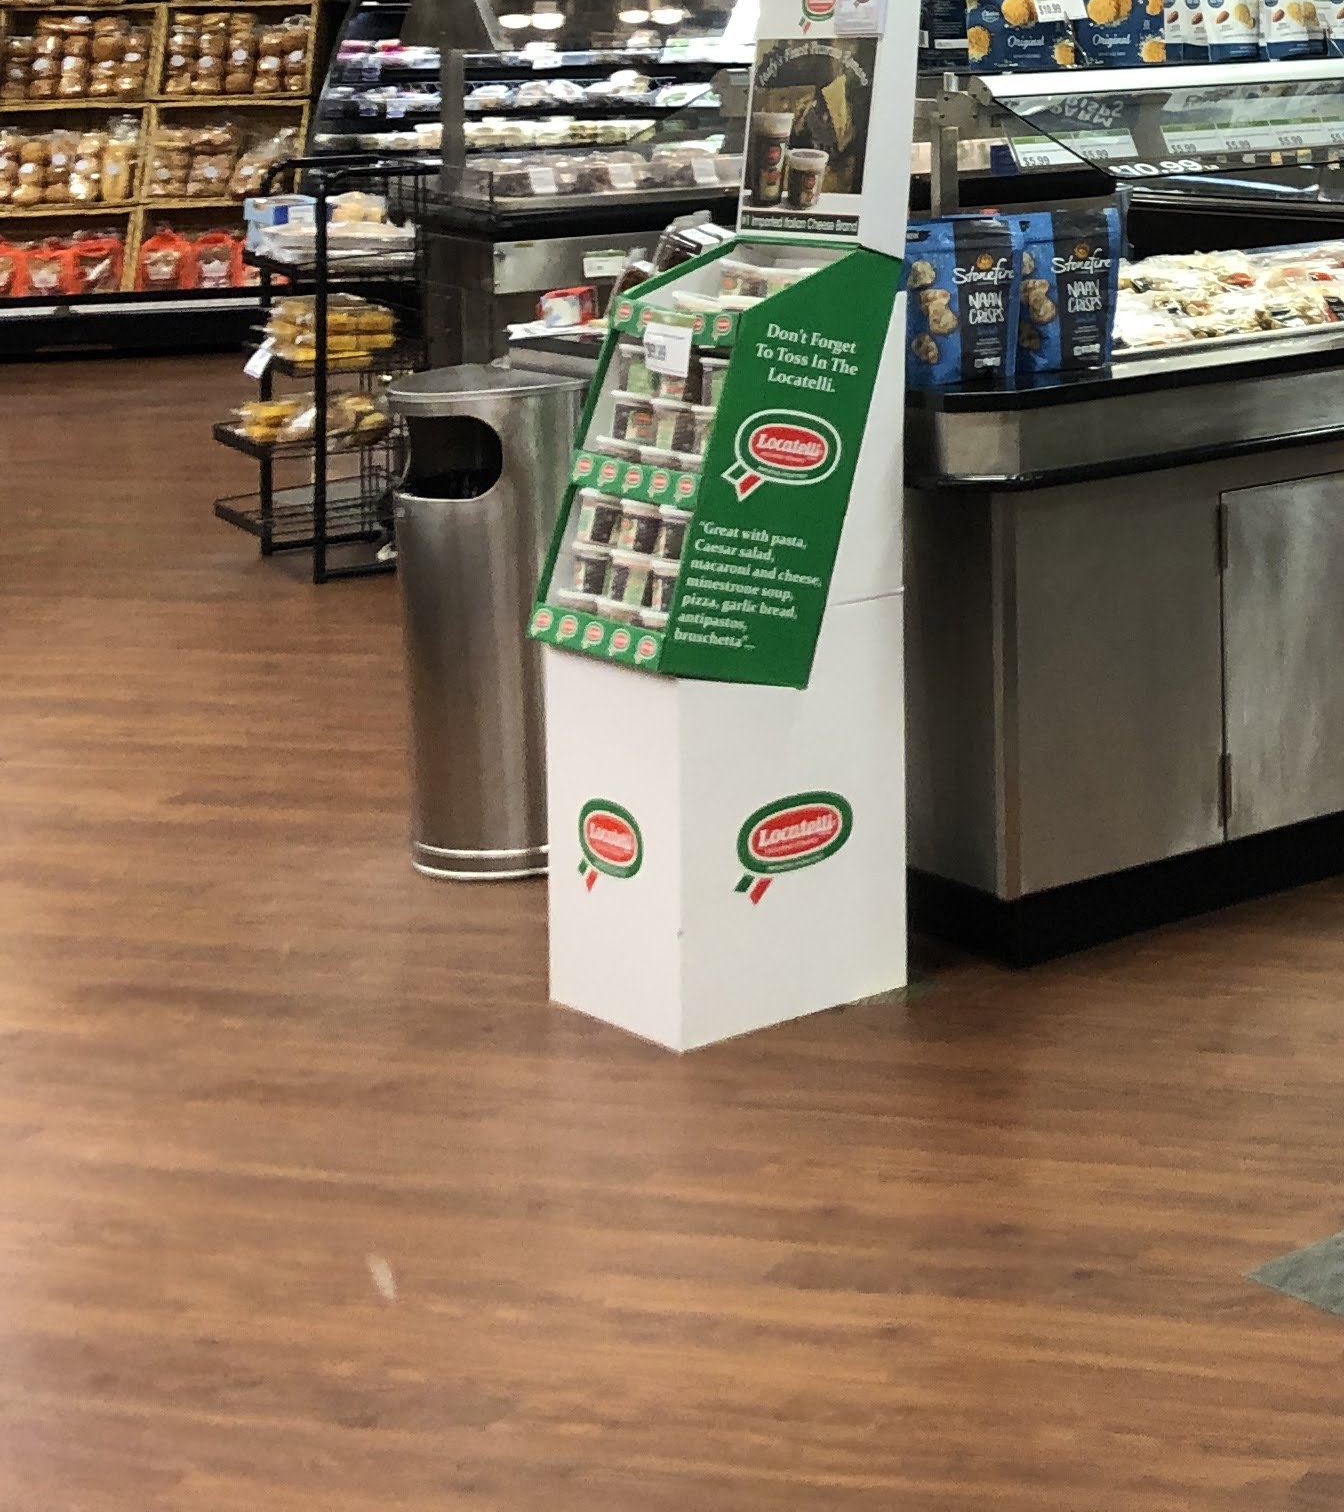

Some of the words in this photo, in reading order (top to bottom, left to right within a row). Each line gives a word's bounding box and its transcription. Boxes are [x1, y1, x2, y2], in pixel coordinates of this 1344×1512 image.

[1008, 35, 1045, 48] Original
[1093, 34, 1130, 48] Original
[1051, 248, 1112, 274] Stonefire
[968, 291, 1003, 309] NAAN
[767, 323, 808, 344] Don't
[810, 332, 857, 355] Forget
[756, 343, 774, 359] To
[777, 347, 809, 366] Toss
[811, 354, 828, 369] In
[831, 357, 859, 375] The
[767, 367, 836, 393] Locatelli.
[756, 433, 823, 457] Locatelli
[741, 528, 769, 543] with
[694, 539, 738, 556] Caesar
[690, 559, 751, 576] macaroni
[752, 566, 777, 580] and
[685, 576, 759, 595] minestrone
[721, 599, 758, 613] garlic
[758, 813, 834, 848] Locatelli
